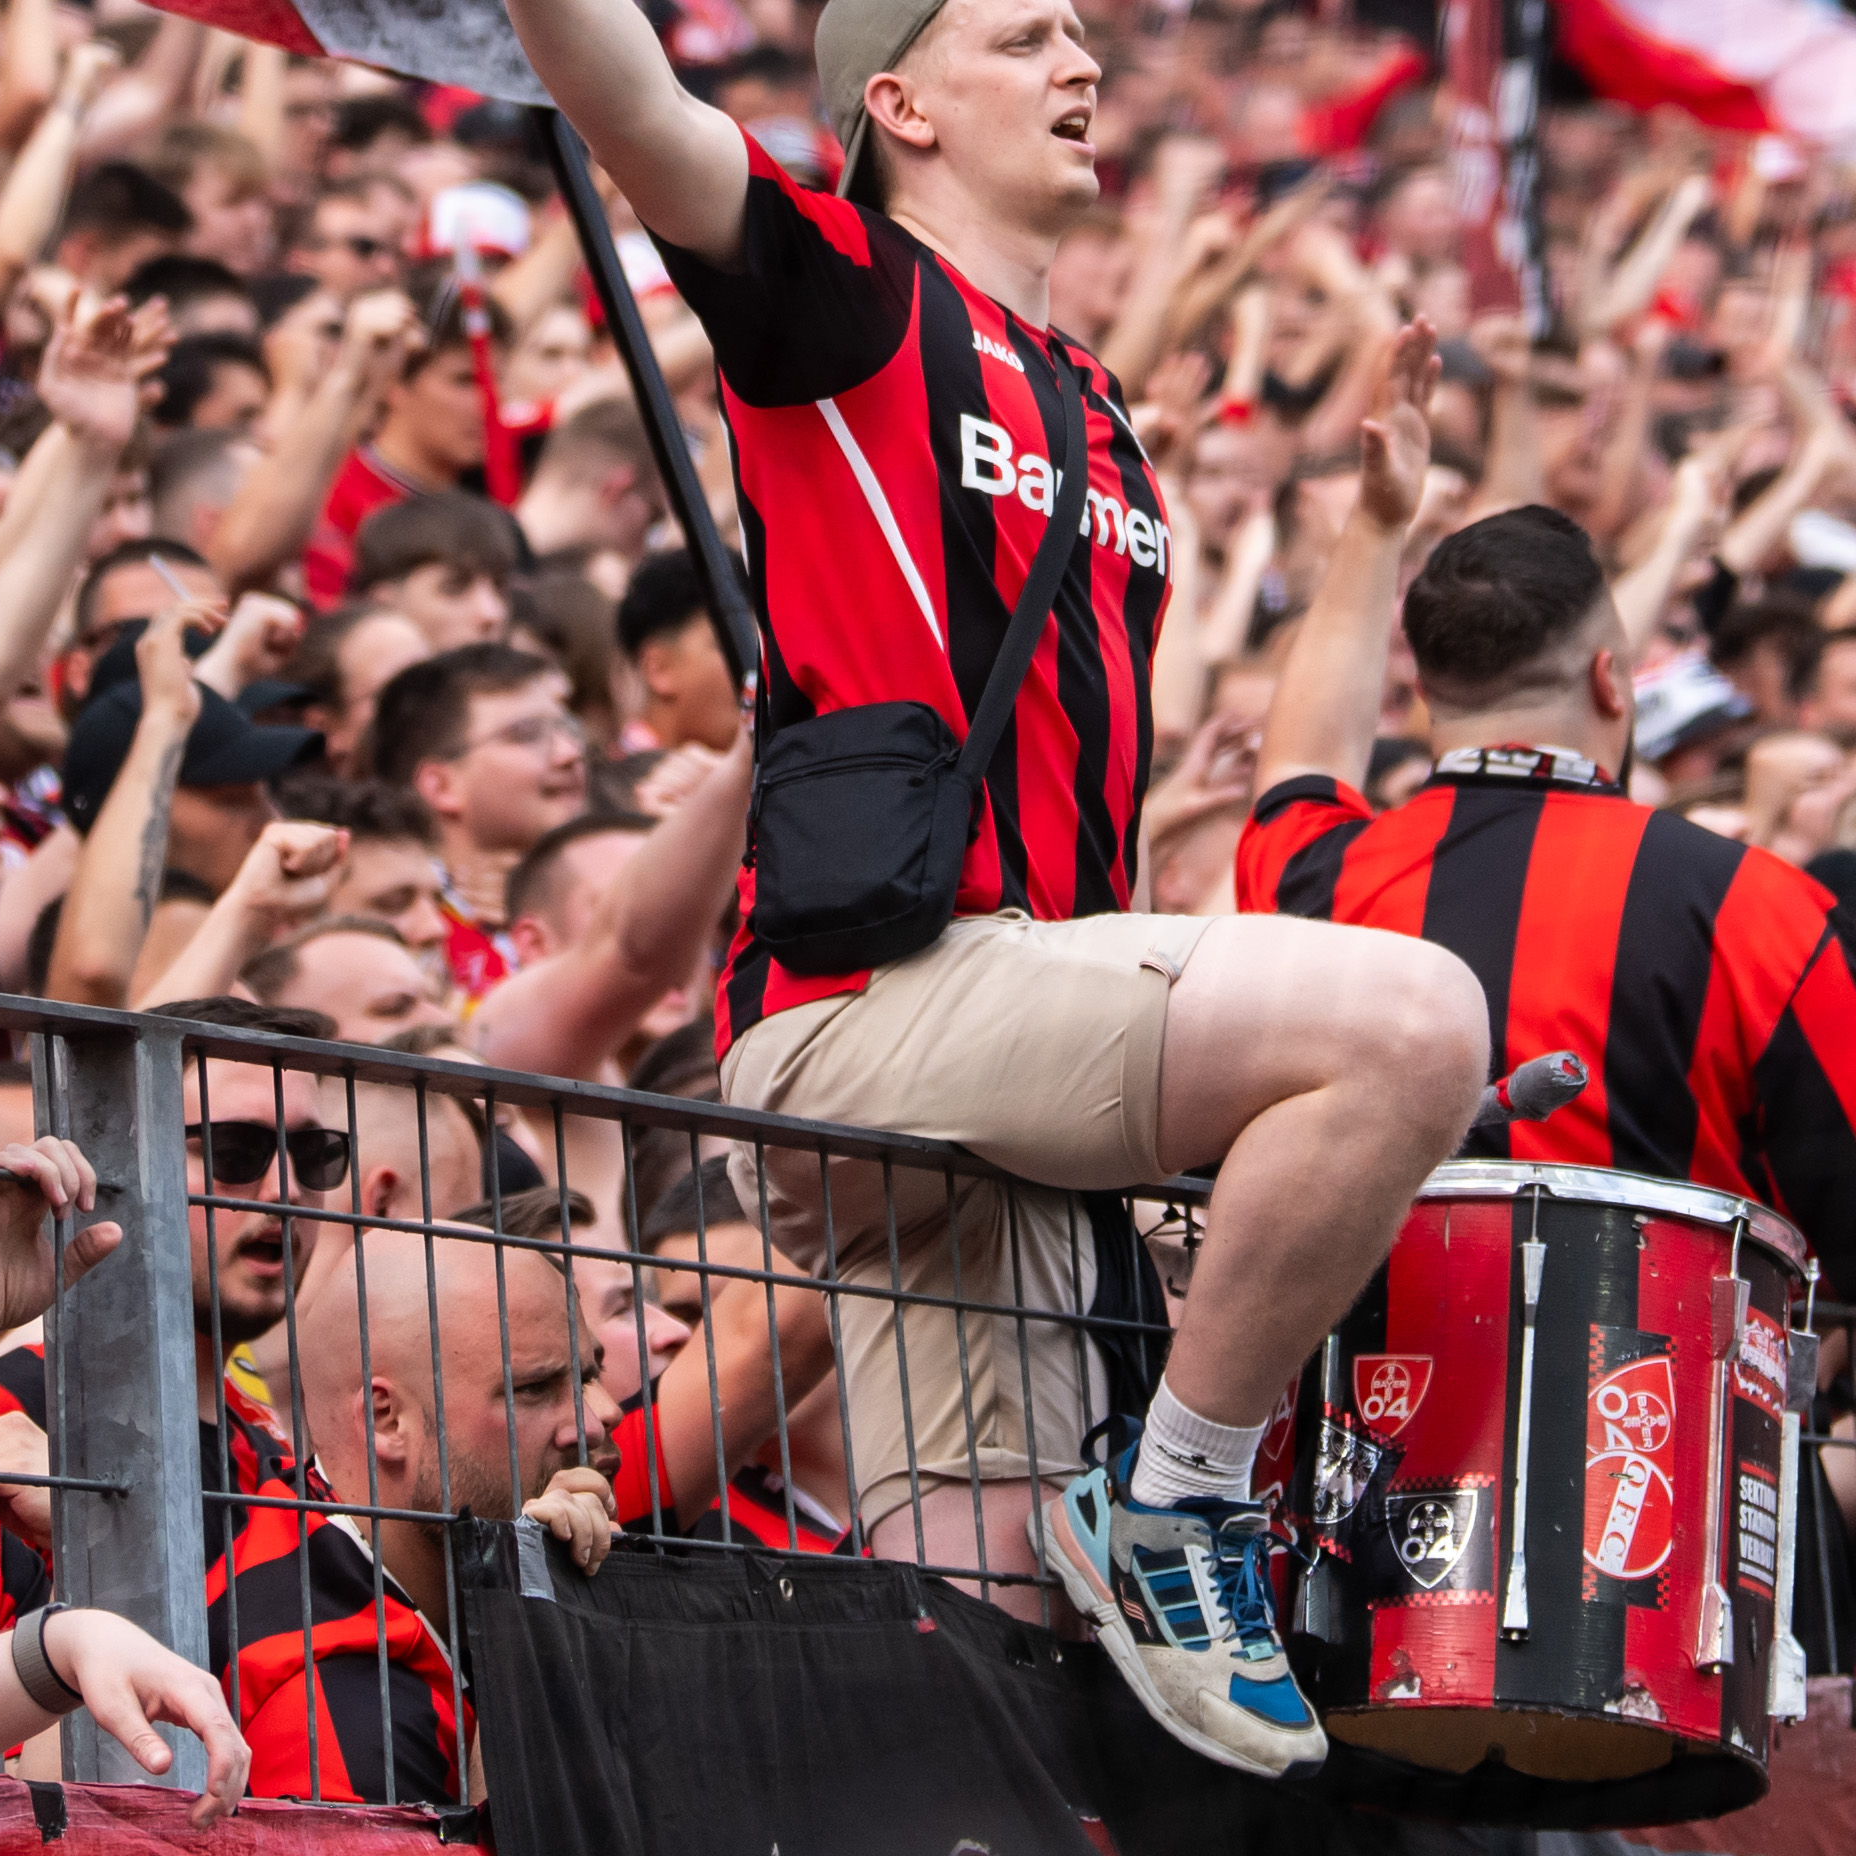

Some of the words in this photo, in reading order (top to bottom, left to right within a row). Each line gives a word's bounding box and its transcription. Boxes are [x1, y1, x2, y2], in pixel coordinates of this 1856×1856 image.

[971, 330, 1025, 373] JAKO
[1364, 1396, 1410, 1420] 04
[1401, 1534, 1459, 1564] 04
